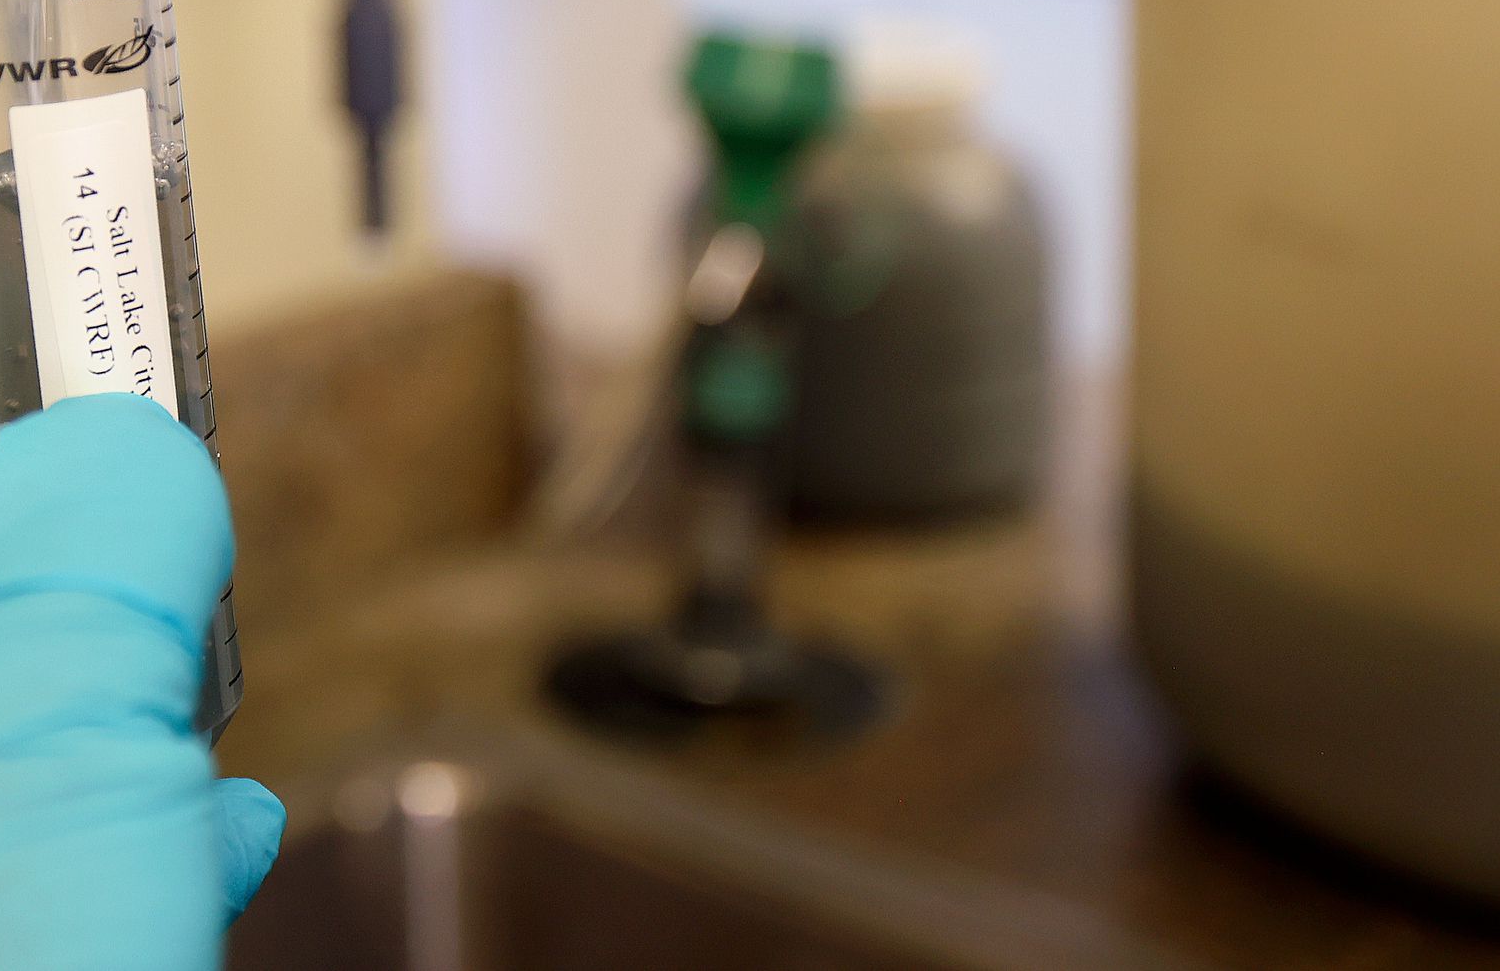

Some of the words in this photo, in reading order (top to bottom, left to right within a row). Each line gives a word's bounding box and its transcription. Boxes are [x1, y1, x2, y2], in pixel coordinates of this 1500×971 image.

[73, 168, 98, 199] 14
[107, 205, 132, 258] Salt
[117, 267, 143, 334] Lake
